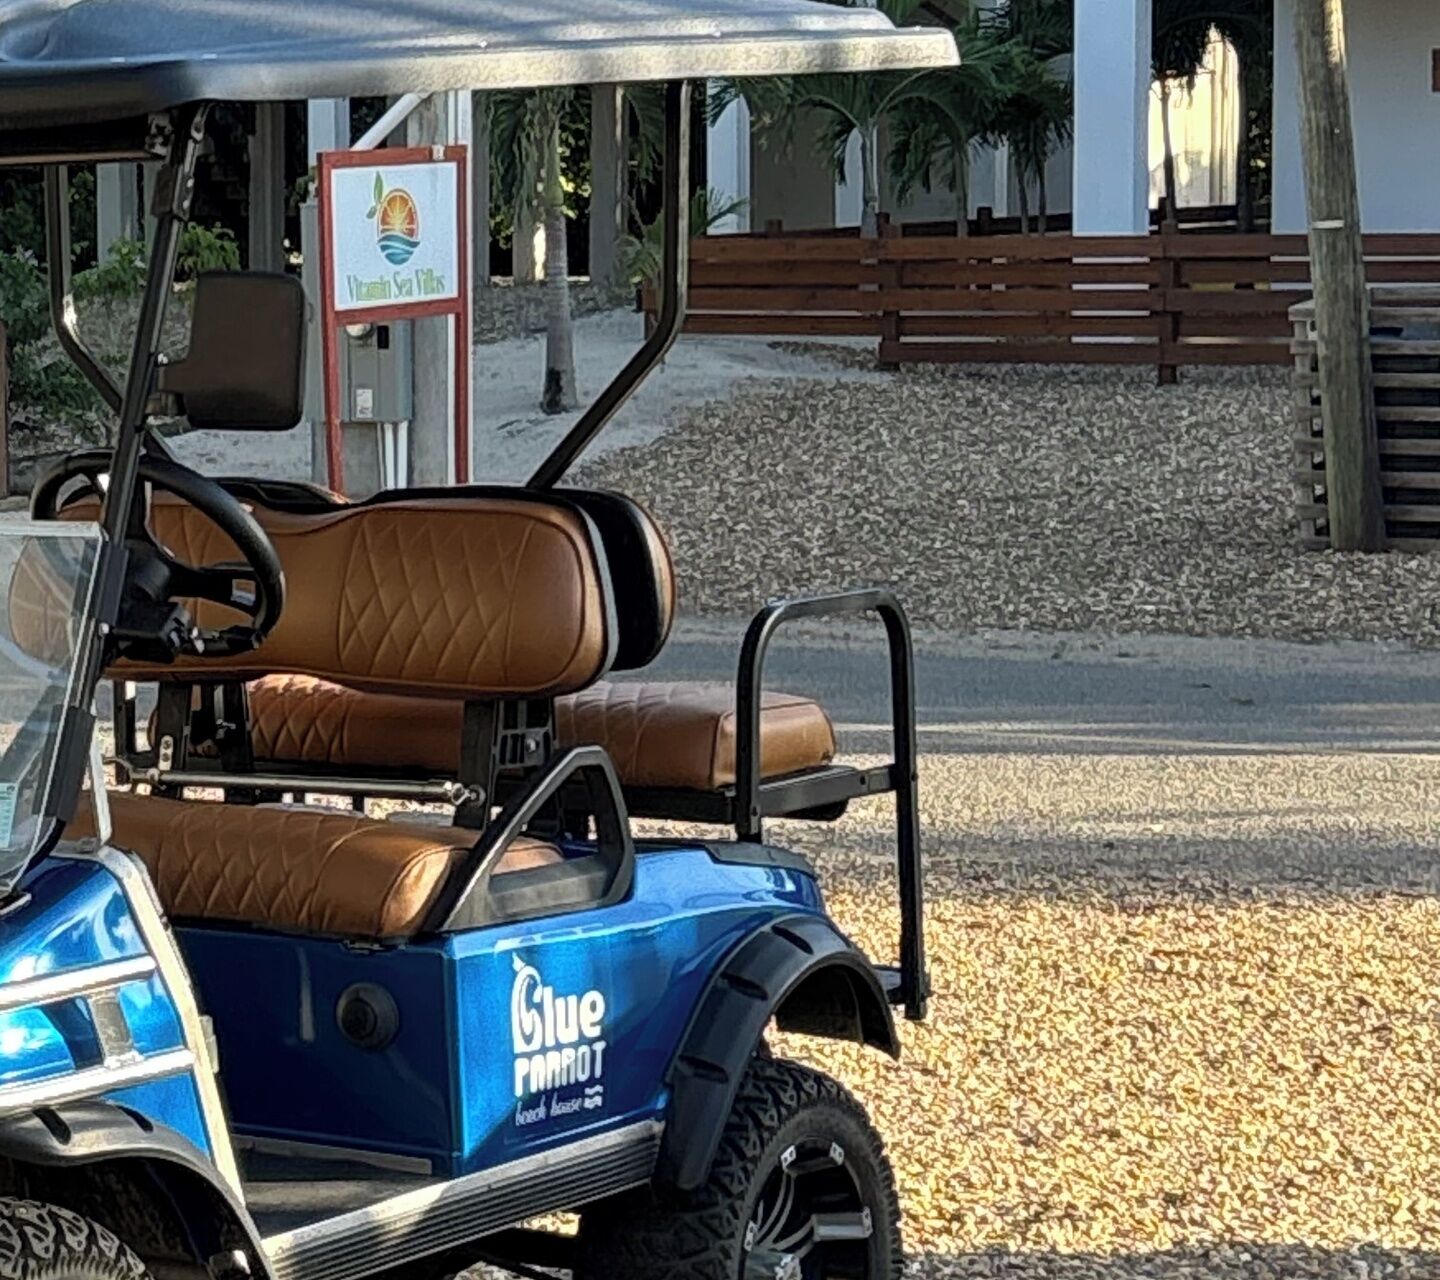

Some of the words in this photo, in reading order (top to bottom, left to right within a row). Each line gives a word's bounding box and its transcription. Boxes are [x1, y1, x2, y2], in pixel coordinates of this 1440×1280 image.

[346, 274, 392, 303] Vitamin
[393, 271, 413, 299] Sea
[512, 965, 606, 1054] Blue
[514, 1041, 607, 1098] PARROT
